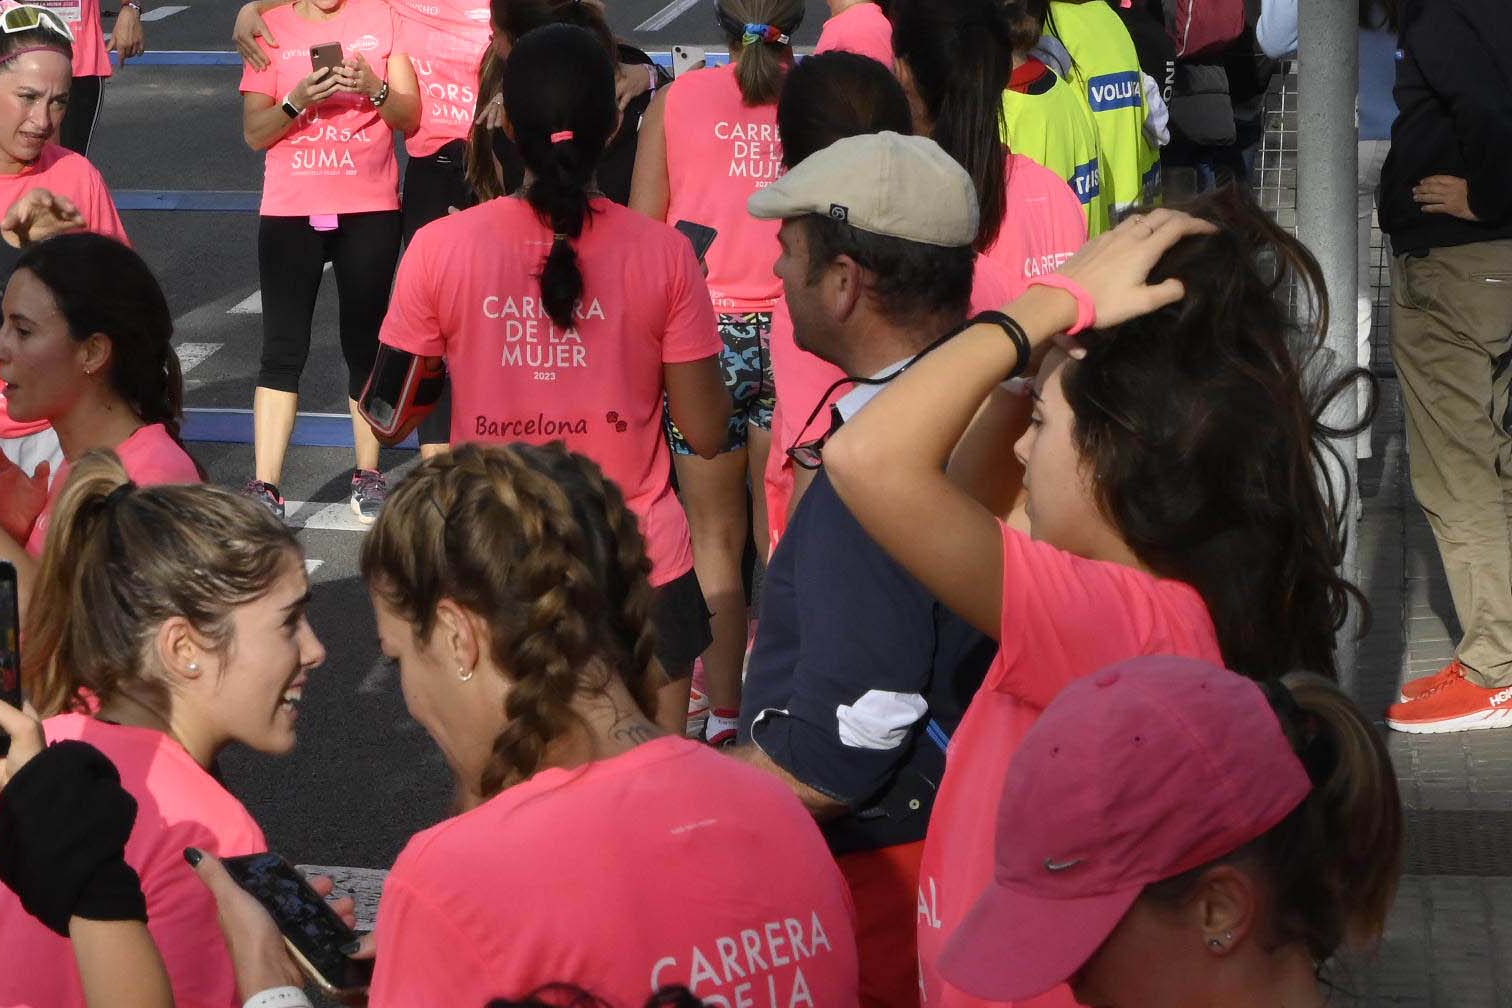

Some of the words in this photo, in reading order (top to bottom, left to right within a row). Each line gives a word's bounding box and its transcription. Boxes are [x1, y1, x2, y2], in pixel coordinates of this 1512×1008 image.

[292, 149, 355, 170] SUMA
[735, 142, 761, 160] DE
[506, 320, 537, 343] DE
[549, 323, 582, 343] LA
[501, 344, 587, 368] MUJER
[534, 372, 556, 381] 2023
[475, 413, 588, 436] Barcelona
[650, 910, 832, 992] CARRERA
